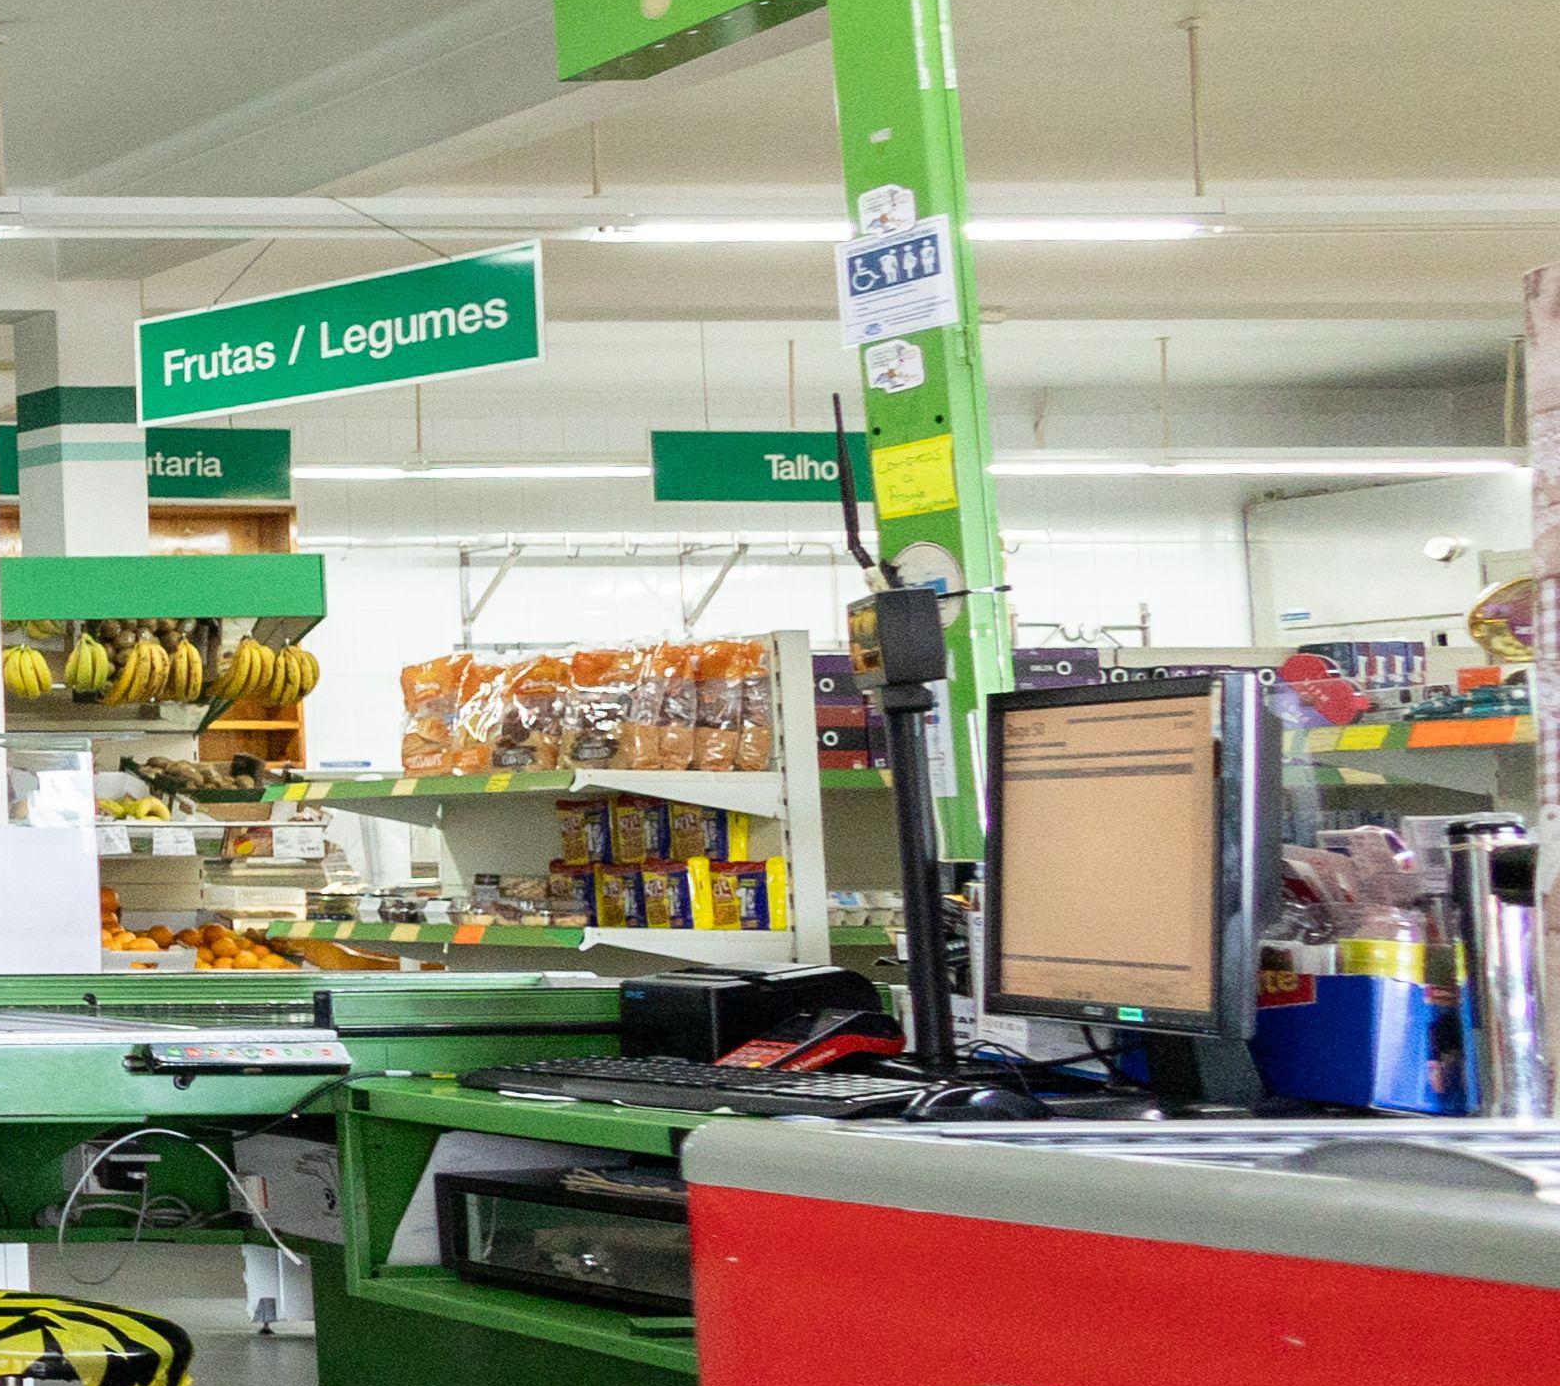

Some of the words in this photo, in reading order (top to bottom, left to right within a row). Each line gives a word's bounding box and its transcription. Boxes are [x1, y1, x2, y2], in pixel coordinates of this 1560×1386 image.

[162, 335, 276, 386] Frutas
[288, 326, 306, 366] /
[320, 295, 509, 362] Legumes
[147, 452, 223, 479] utaria
[764, 453, 838, 481] Talho
